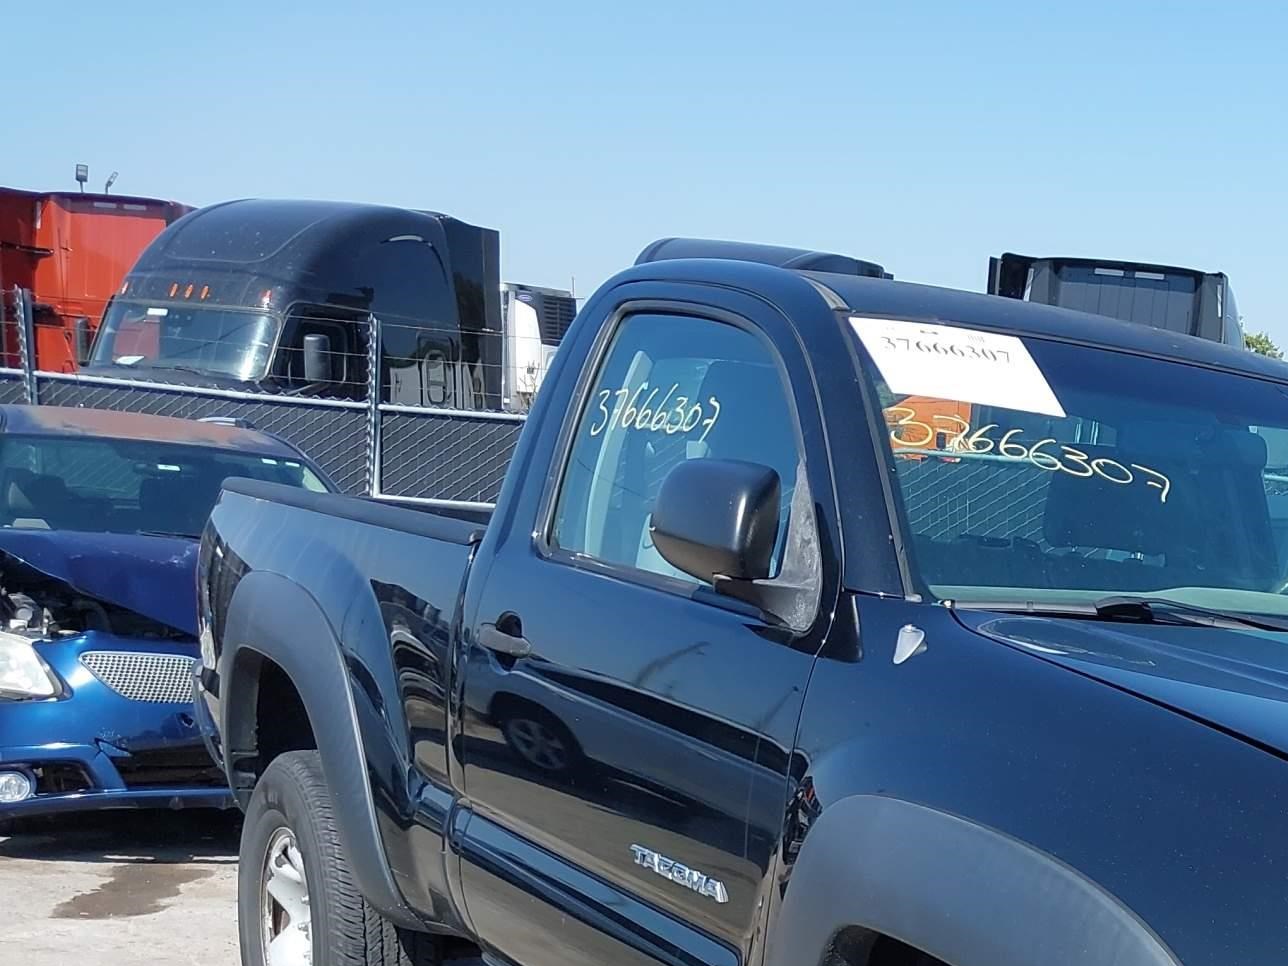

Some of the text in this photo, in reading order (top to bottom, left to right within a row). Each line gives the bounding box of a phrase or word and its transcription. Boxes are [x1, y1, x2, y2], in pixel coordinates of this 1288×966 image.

[881, 336, 1010, 363] 37666307
[591, 382, 721, 443] 37666307
[883, 407, 1171, 503] 37666307
